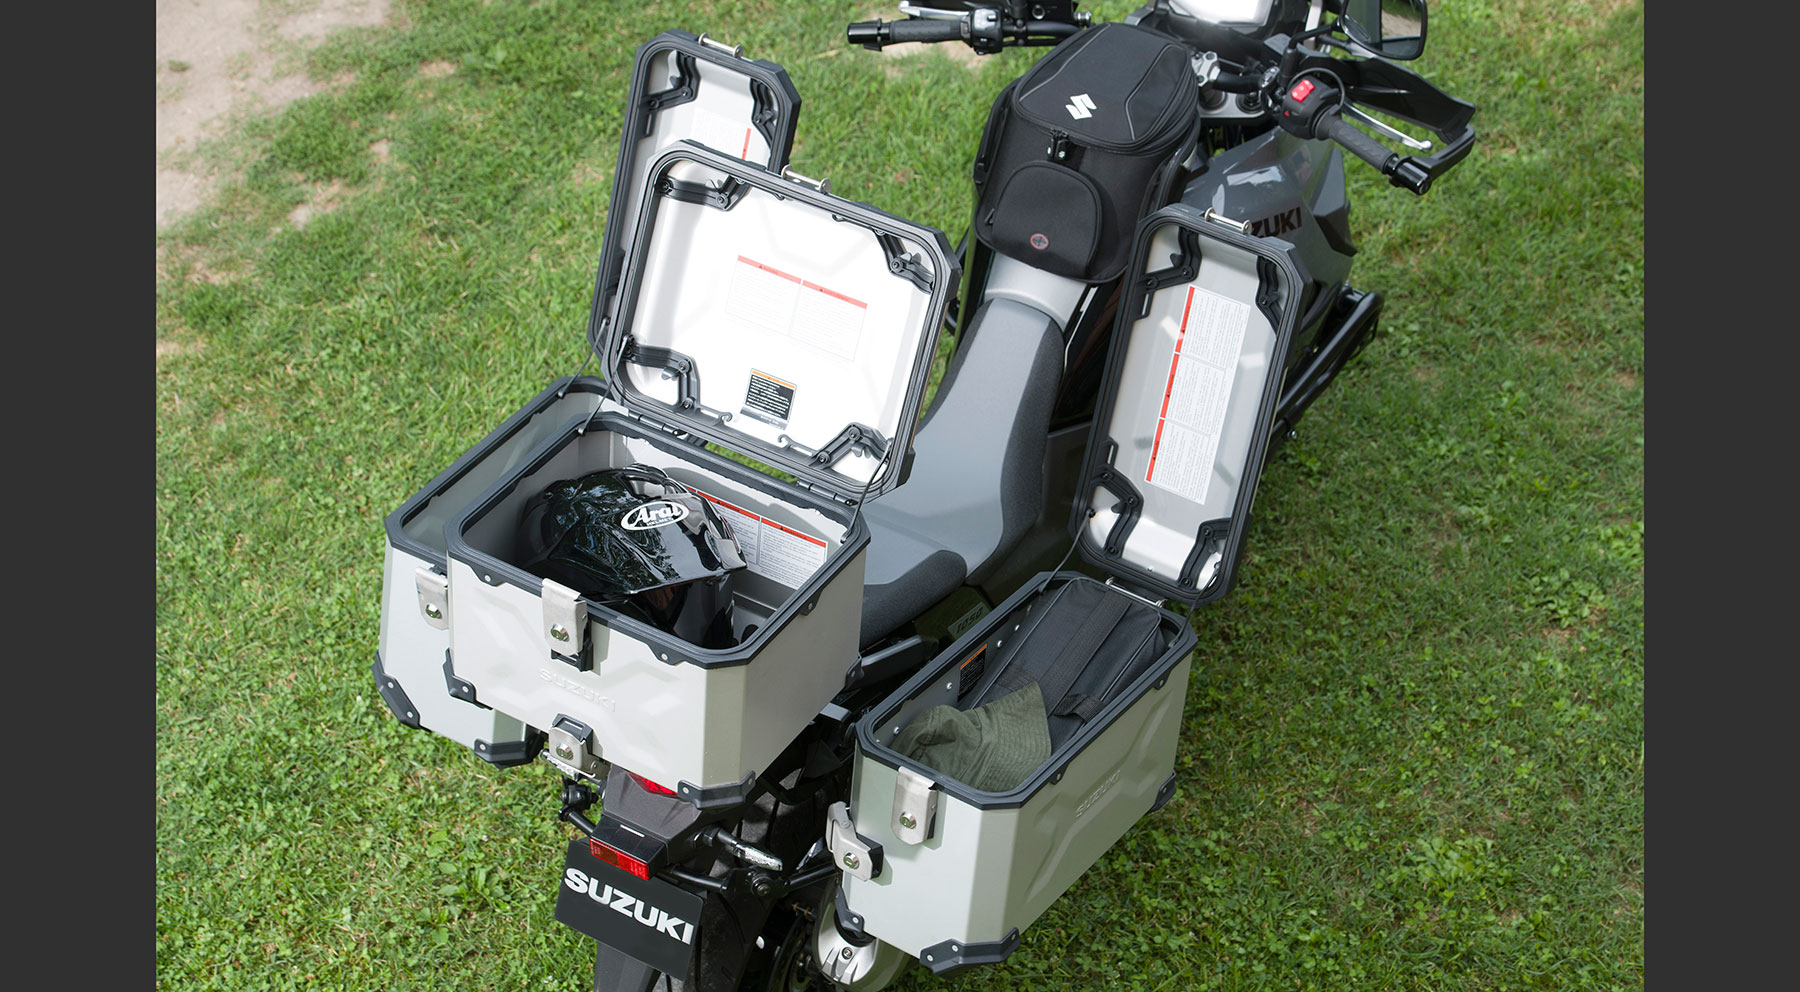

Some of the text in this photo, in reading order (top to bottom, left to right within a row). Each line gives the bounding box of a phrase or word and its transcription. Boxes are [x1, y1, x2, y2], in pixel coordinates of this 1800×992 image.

[1251, 206, 1302, 238] ZUKI
[628, 503, 682, 528] Arai
[539, 668, 616, 713] SUZUKI
[564, 867, 694, 945] SUZUKI
